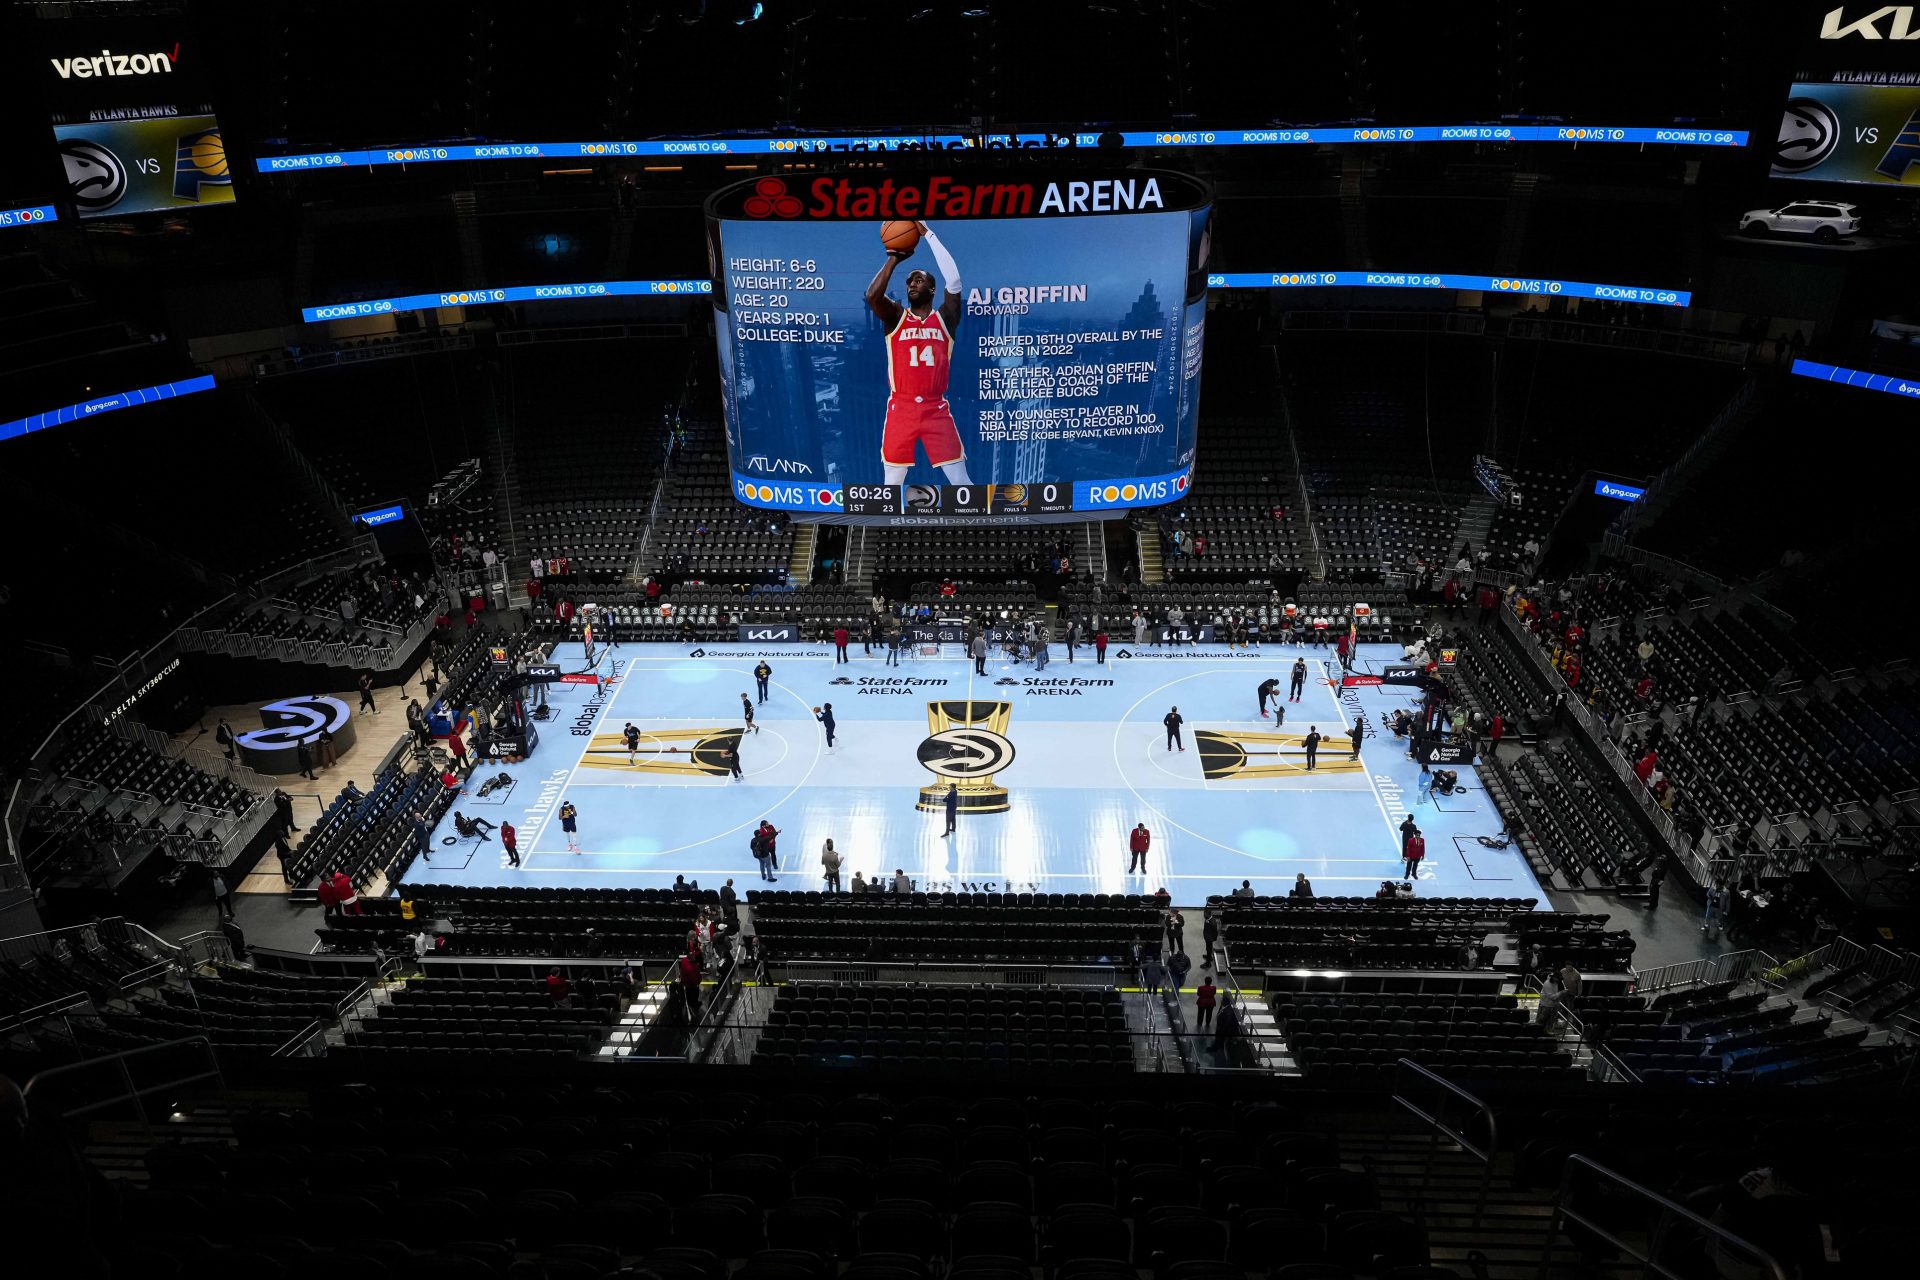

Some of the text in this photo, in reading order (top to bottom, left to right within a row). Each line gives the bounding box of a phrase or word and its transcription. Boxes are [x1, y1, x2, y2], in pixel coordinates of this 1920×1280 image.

[1820, 5, 1920, 40] KI
[51, 49, 172, 79] verizon
[1832, 70, 1920, 84] ATLANTA HAW
[89, 104, 178, 121] ATLANTA HAWKS
[1155, 133, 1197, 144] ROOMS
[1243, 131, 1310, 142] ROOMS TO GO
[1353, 129, 1396, 140] ROOMS
[1442, 128, 1511, 138] ROOMS TO GO
[1558, 128, 1605, 139] ROOMS
[1656, 130, 1733, 143] ROOMS TO GO
[1855, 126, 1879, 144] VS
[475, 146, 539, 157] ROOMS TO GO
[580, 144, 621, 154] ROOMS
[663, 142, 727, 152] ROOMS TO GO
[271, 155, 342, 169] ROOMS TO GO
[387, 149, 430, 162] ROOMS
[135, 158, 161, 175] VS
[1038, 177, 1164, 214] ARENA
[730, 257, 817, 273] HEIGHT: 6-6
[731, 275, 825, 291] WEIGHT: 220
[1208, 276, 1225, 285] GO
[1272, 274, 1317, 285] ROOMS
[1367, 274, 1440, 286] ROOMS TO GO
[1491, 278, 1541, 292] ROOMS
[535, 284, 606, 297] ROOMS TO GO
[651, 282, 694, 293] ROOMS
[966, 284, 1088, 305] AJ GRIFFIN
[1594, 286, 1677, 303] ROOMS TO GO
[440, 291, 486, 305] ROOMS
[733, 293, 788, 308] AGE: 20
[316, 301, 392, 319] ROOMS TO GO
[967, 304, 1029, 316] FORWARD
[735, 310, 831, 326] YEARS PRO: 1
[736, 327, 845, 343] COLLEGE: DUKE
[898, 327, 945, 342] ATLANTA
[978, 328, 1163, 347] DRAFTED 16TH OVERALL BY THE
[909, 345, 935, 367] 14
[978, 344, 1074, 358] HAWKS IN 2022
[979, 361, 1157, 379] HIS FATHER, ADRIAN GRIFFIN,
[979, 373, 1149, 390] IS THE HEAD COACH OF THE
[979, 386, 1099, 400] MILWAUKEE BUCKS
[91, 399, 119, 412] gng.com
[979, 404, 1139, 421] 3RD YOUNGEST PLAYER IN
[979, 413, 1156, 431] NBA HISTORY TO RECORD 100
[979, 424, 1164, 442] TRIPLES (KOBE BRYANT, KEVIN KNOX)
[748, 457, 812, 474] ATLANTA
[737, 479, 803, 505] ROOMS
[849, 486, 892, 500] 60:26
[956, 486, 971, 505] 0
[1043, 484, 1058, 503] 0
[1089, 481, 1167, 504] ROOMS
[849, 504, 894, 513] 1ST 23
[889, 515, 1029, 527] globalpayments
[913, 630, 934, 641] The
[1134, 651, 1184, 659] Georgia
[163, 658, 180, 675] CLUB
[857, 687, 913, 695] ARENA
[1025, 688, 1082, 696] ARENA
[523, 769, 570, 813] hawks
[960, 881, 997, 893] we
